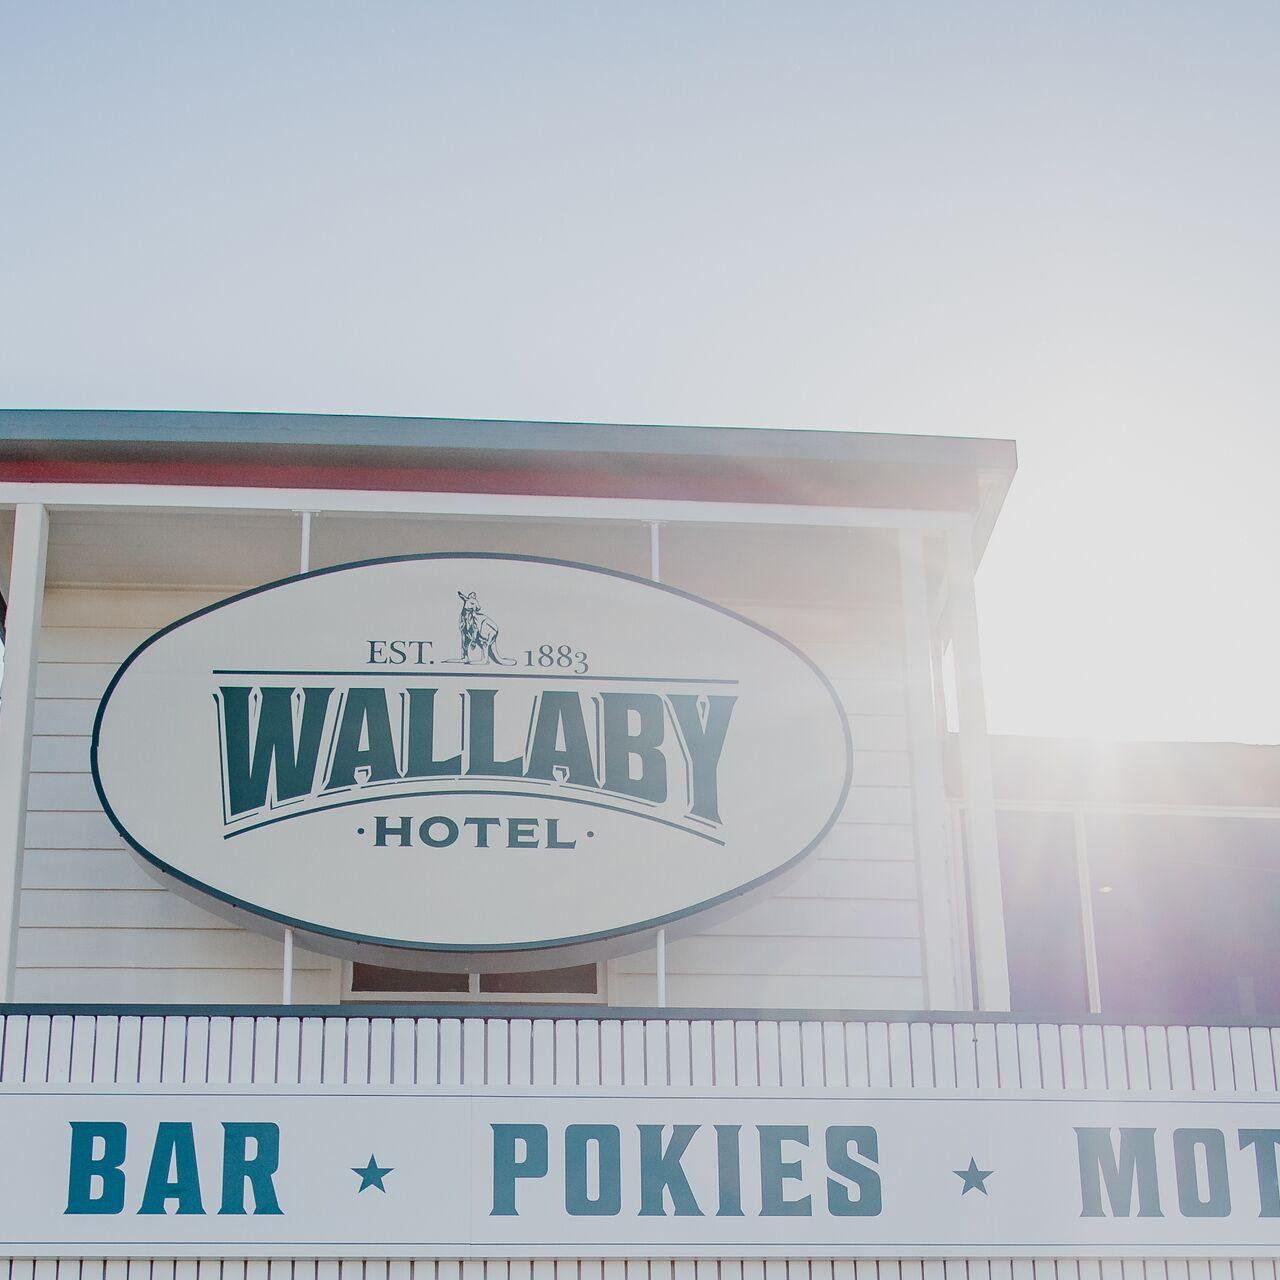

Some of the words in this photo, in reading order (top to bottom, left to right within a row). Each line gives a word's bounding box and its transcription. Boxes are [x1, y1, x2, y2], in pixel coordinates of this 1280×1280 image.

[365, 639, 436, 666] EST.
[524, 645, 590, 674] 1883
[213, 687, 738, 826] WALLABY
[372, 815, 577, 850] HOTEL
[63, 1120, 285, 1216] BAR
[488, 1122, 883, 1218] POKIES
